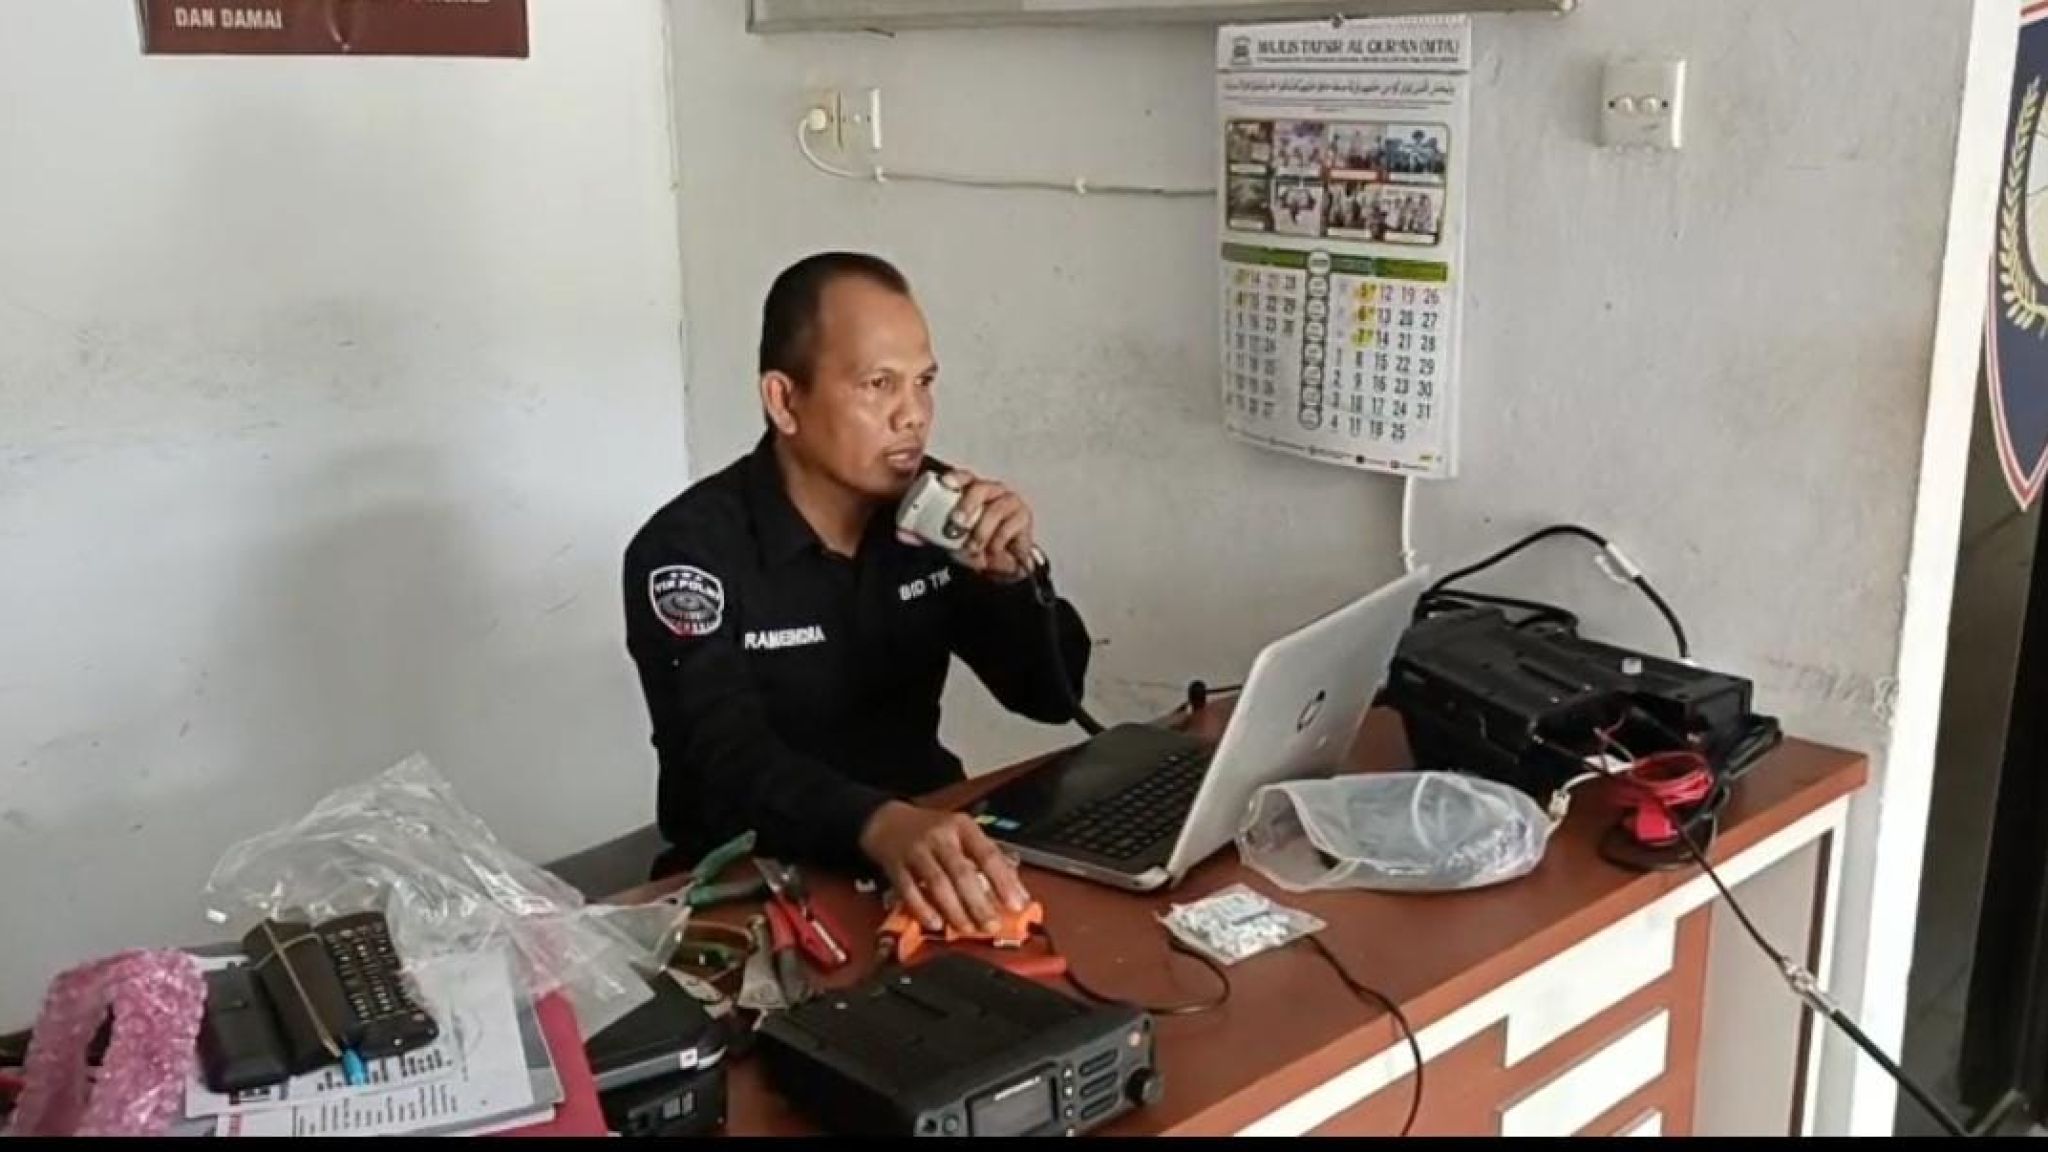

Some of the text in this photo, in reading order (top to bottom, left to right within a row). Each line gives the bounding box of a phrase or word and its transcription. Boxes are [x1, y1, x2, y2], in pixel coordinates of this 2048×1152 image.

[175, 7, 281, 30] DAN DAMAI
[1380, 284, 1393, 303] 12
[1401, 286, 1415, 305] 19
[1423, 287, 1440, 306] 26
[1421, 311, 1437, 329] 27
[1376, 328, 1389, 347] 14
[1397, 331, 1411, 350] 21
[1420, 334, 1436, 352] 28
[1396, 354, 1410, 373] 22
[1419, 358, 1435, 376] 29
[1332, 369, 1340, 387] 2
[1394, 377, 1409, 395] 23
[1417, 379, 1433, 398] 30
[1393, 399, 1407, 417] 24
[1416, 402, 1430, 421] 31
[1391, 422, 1406, 441] 25
[900, 579, 926, 600] BID
